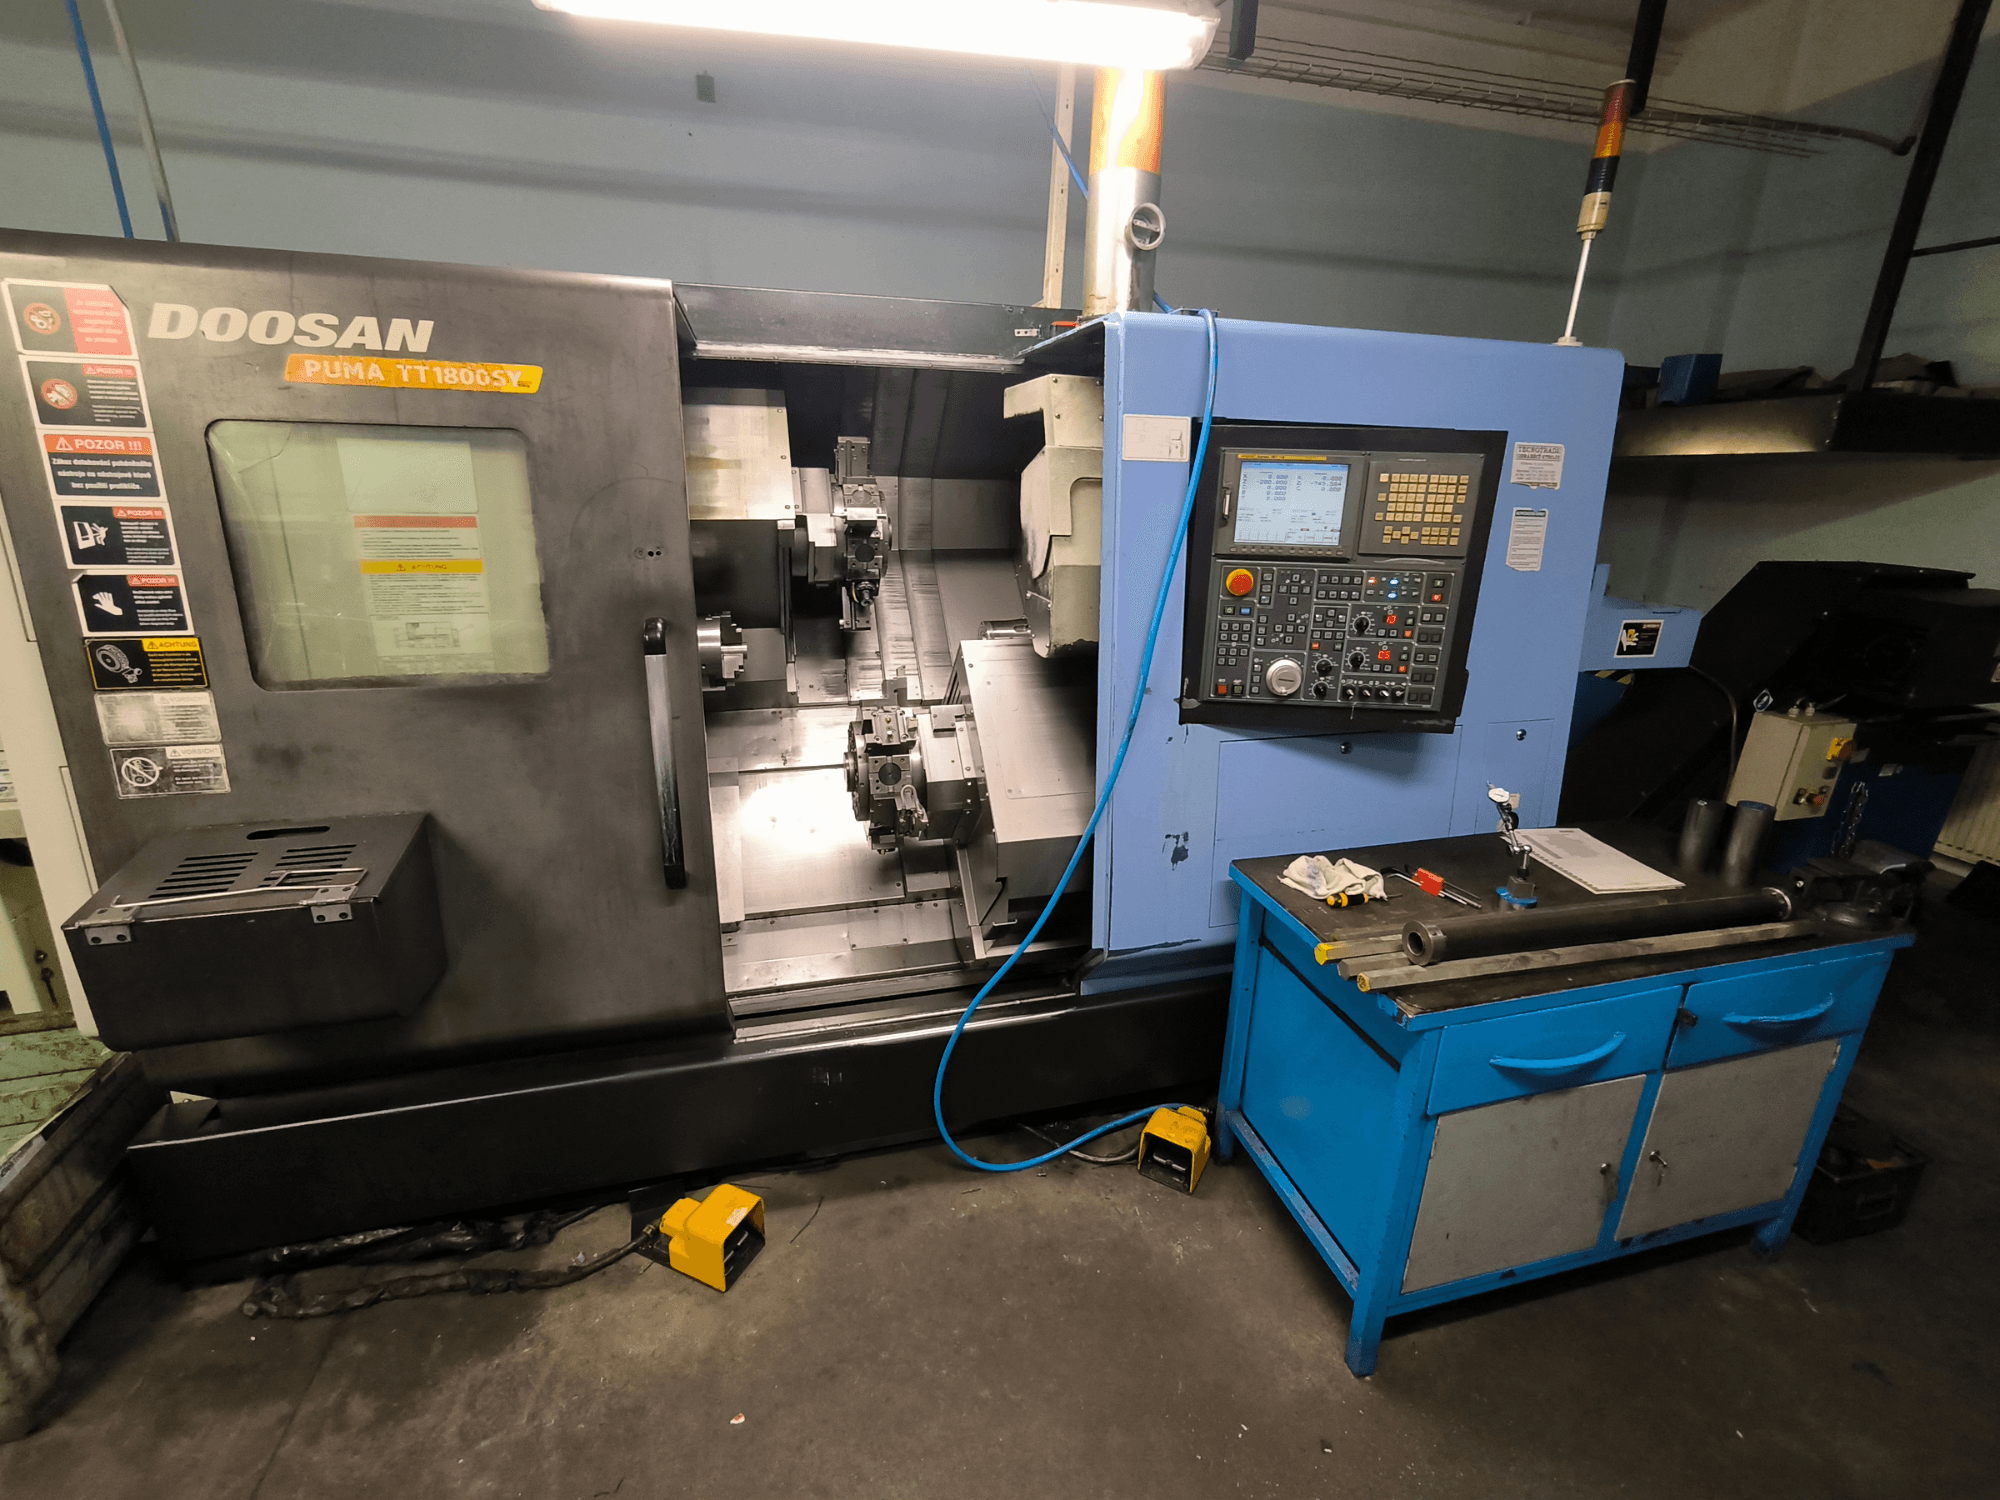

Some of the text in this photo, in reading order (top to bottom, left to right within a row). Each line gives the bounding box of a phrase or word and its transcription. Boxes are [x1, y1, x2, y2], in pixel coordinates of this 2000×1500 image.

[148, 303, 434, 352] DOOSAN
[304, 359, 385, 381] PUMA
[74, 438, 143, 451] POZOR !!!
